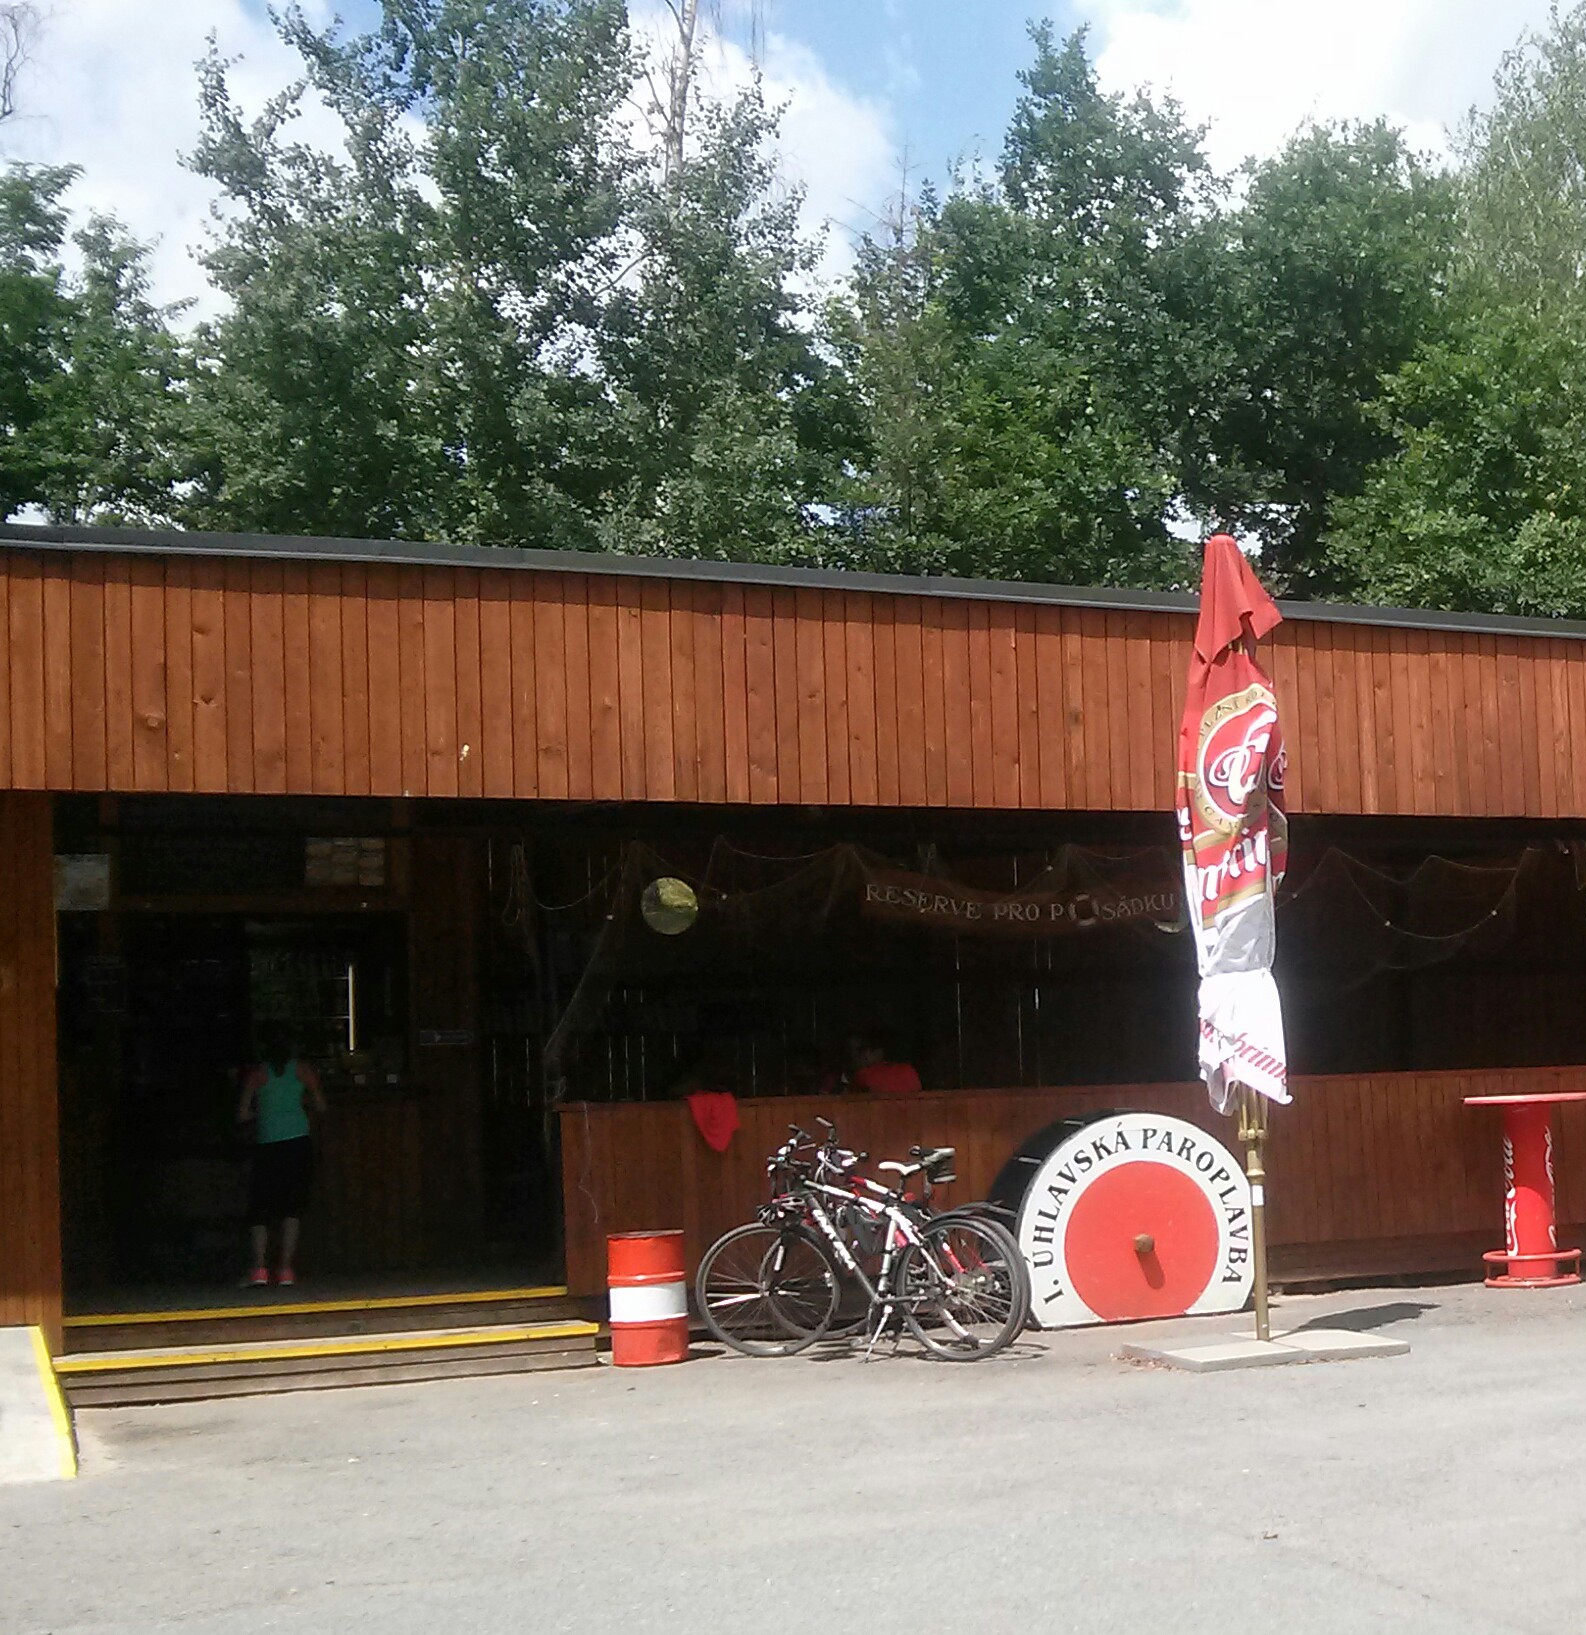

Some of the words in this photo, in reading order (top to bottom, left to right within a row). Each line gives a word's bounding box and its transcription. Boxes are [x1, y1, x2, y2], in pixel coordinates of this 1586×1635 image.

[865, 884, 982, 920] RESERVE
[993, 908, 1040, 921] PRO
[1026, 1122, 1130, 1268] ÚHLAVSKÁ
[1141, 1128, 1249, 1284] PAROPLAVBA
